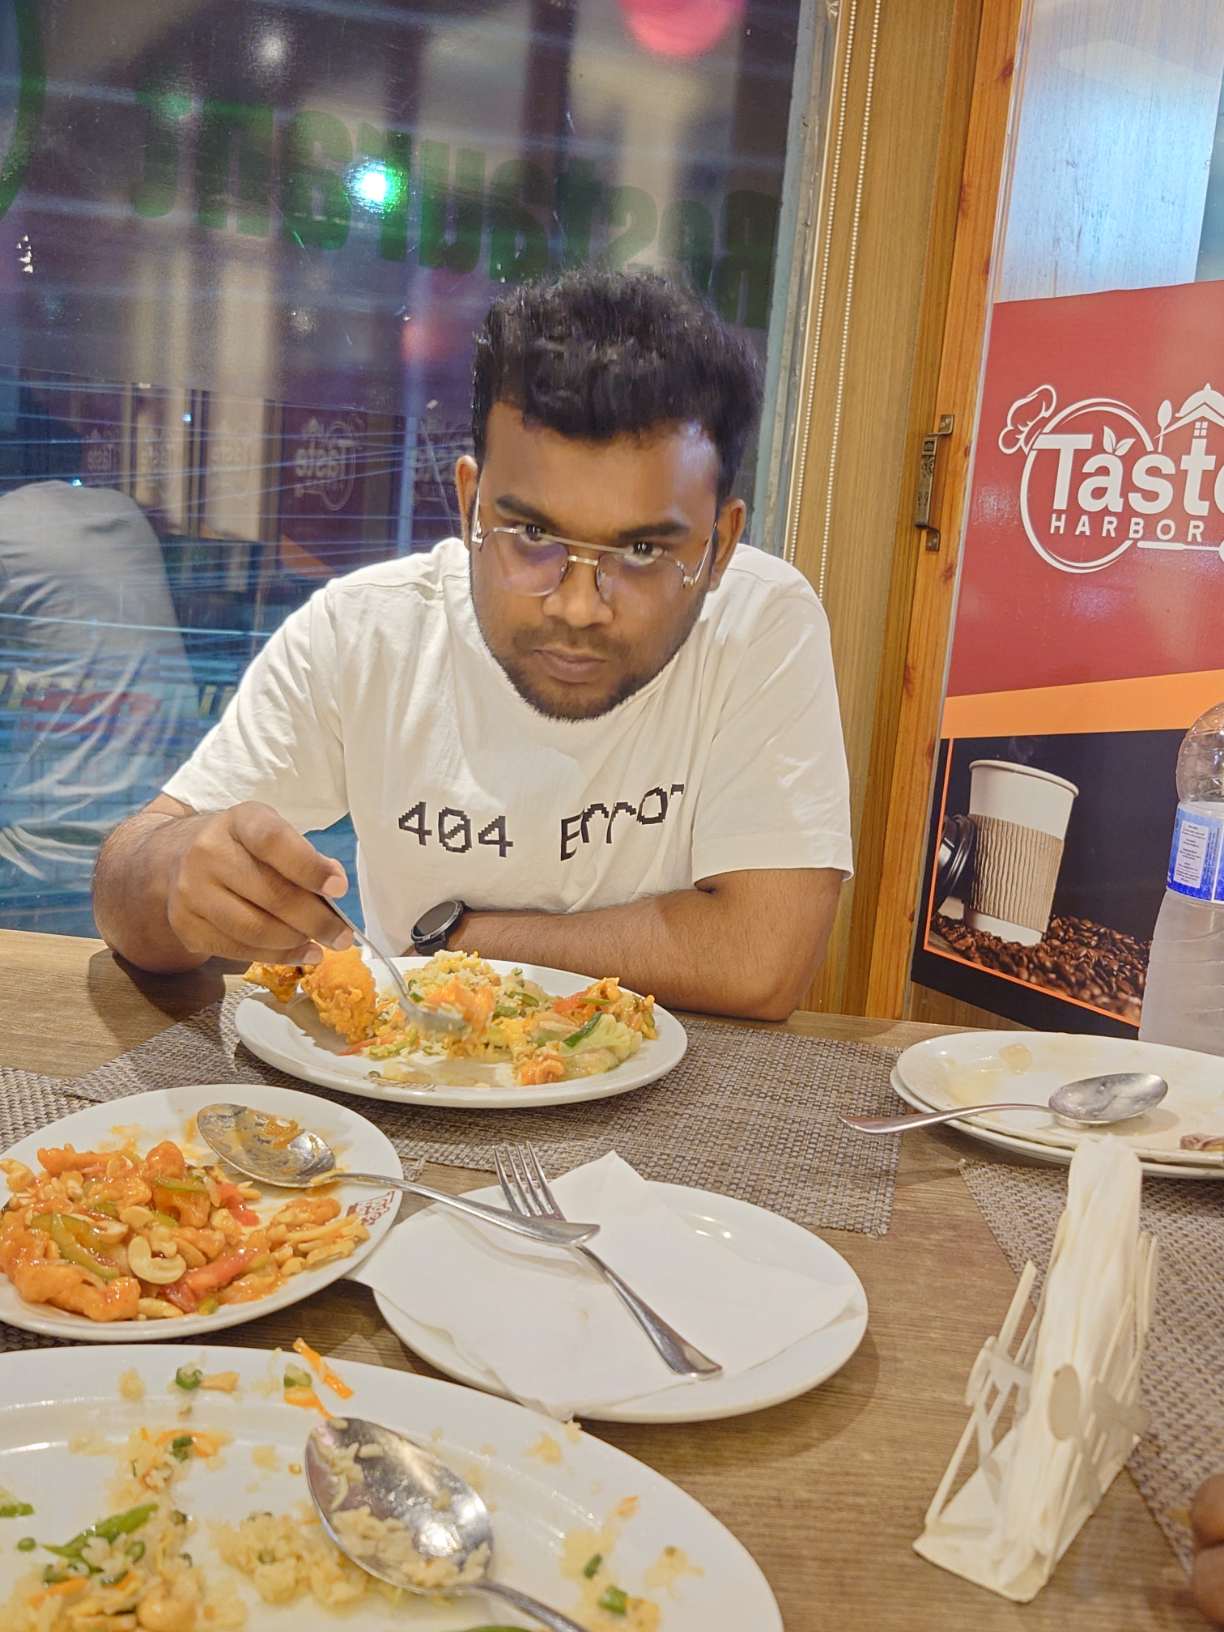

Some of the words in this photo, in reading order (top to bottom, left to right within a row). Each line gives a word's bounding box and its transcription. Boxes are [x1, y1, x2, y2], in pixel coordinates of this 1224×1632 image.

[1031, 433, 1224, 516] Tast
[1050, 514, 1205, 542] HARBOR
[398, 801, 514, 858] 404
